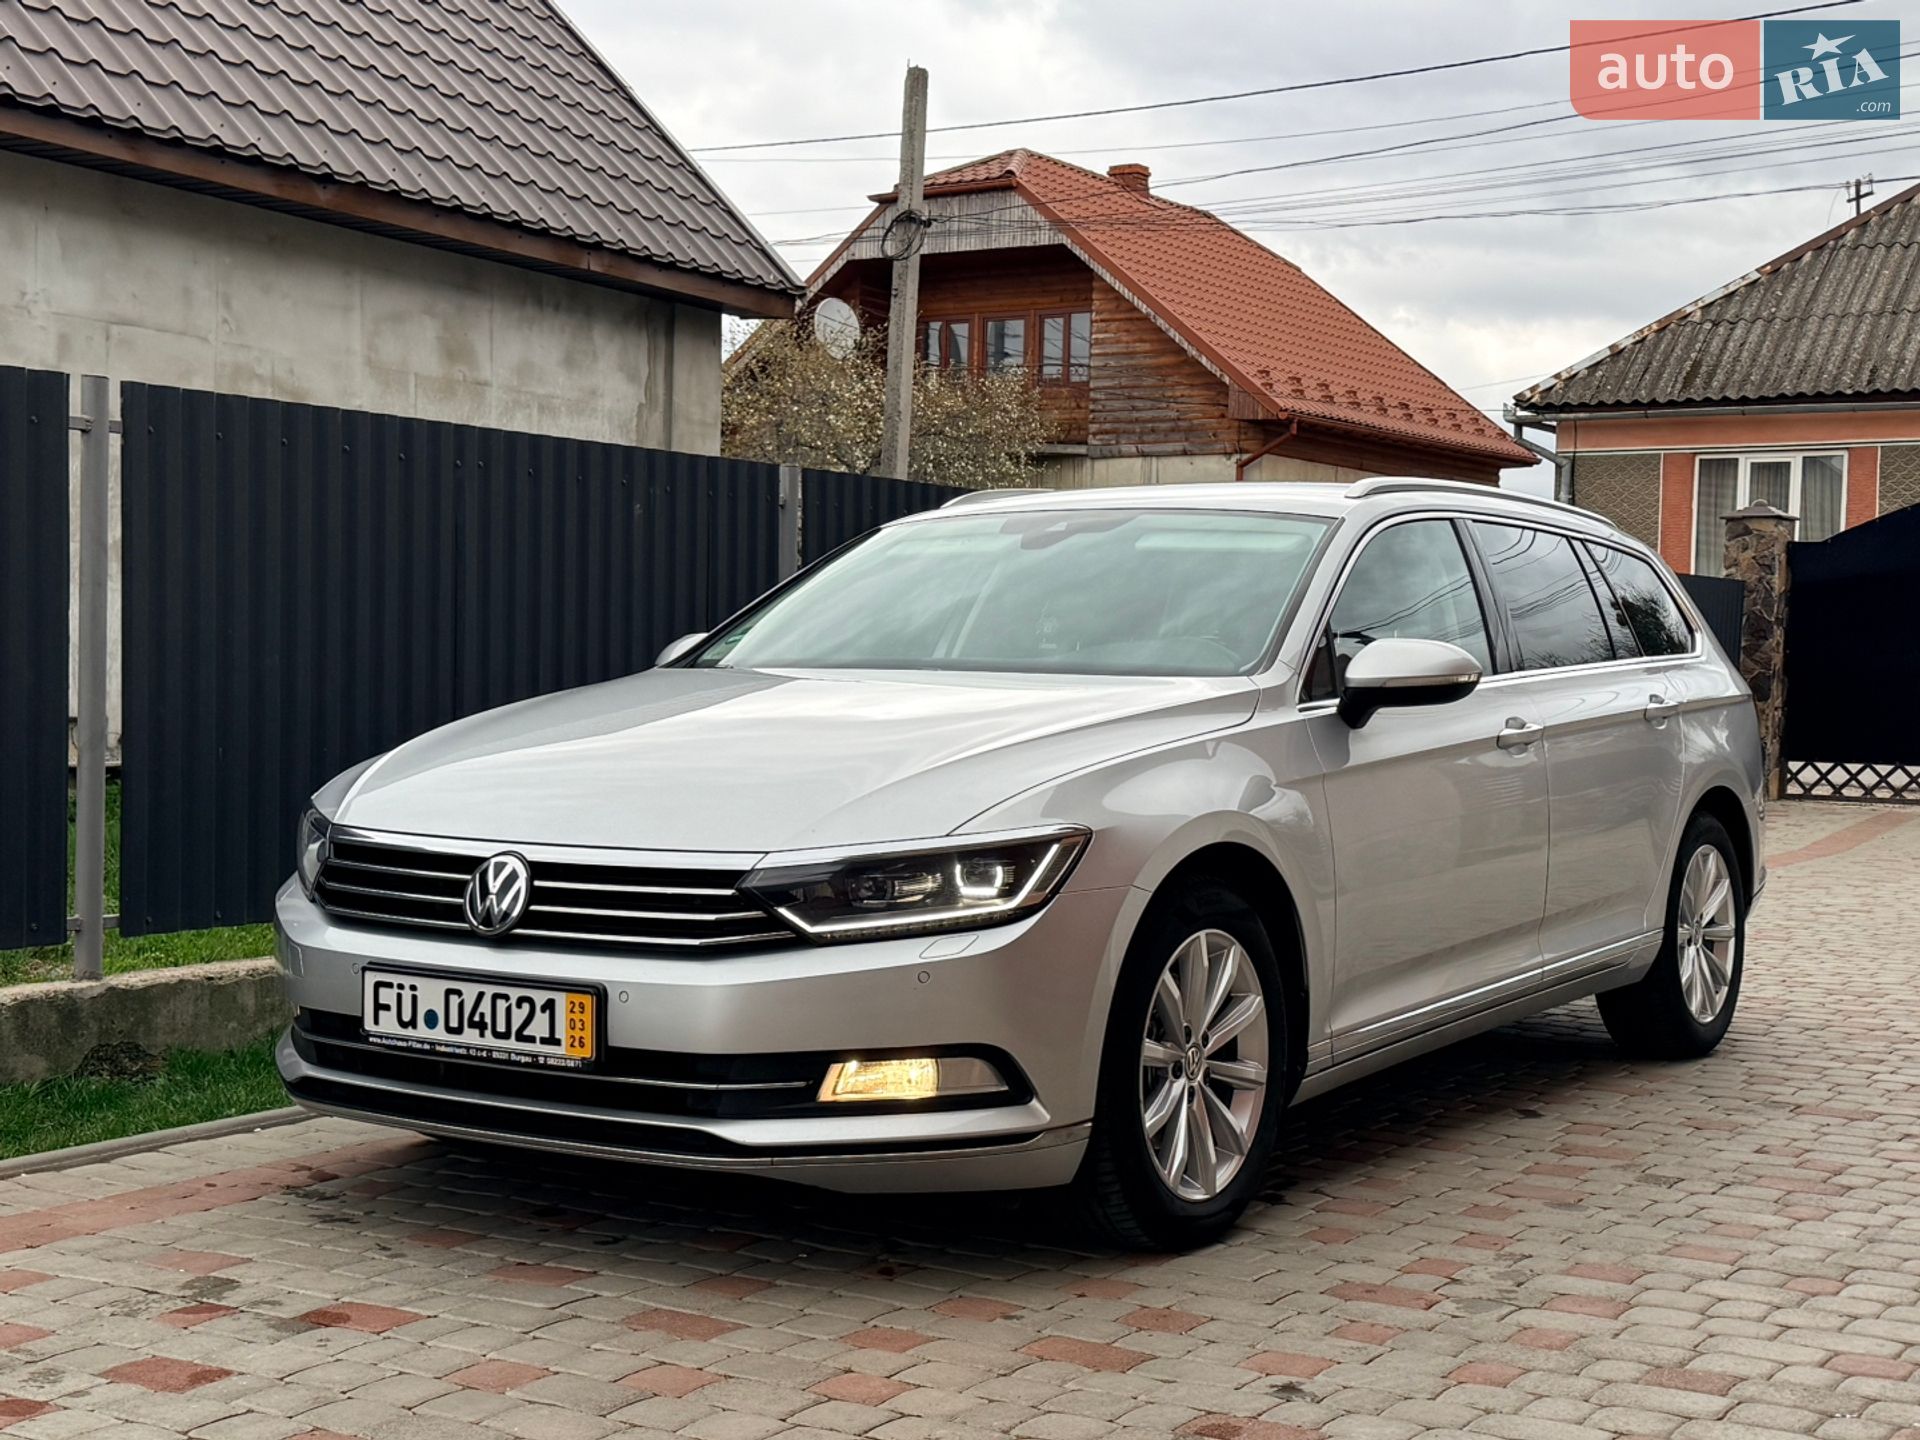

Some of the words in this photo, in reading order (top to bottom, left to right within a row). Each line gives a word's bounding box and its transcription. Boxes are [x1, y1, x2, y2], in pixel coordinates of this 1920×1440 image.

[373, 980, 418, 1031] FÜ
[443, 987, 562, 1047] 04021
[569, 1000, 585, 1015] 29
[569, 1017, 585, 1032] 03
[569, 1035, 586, 1049] 26
